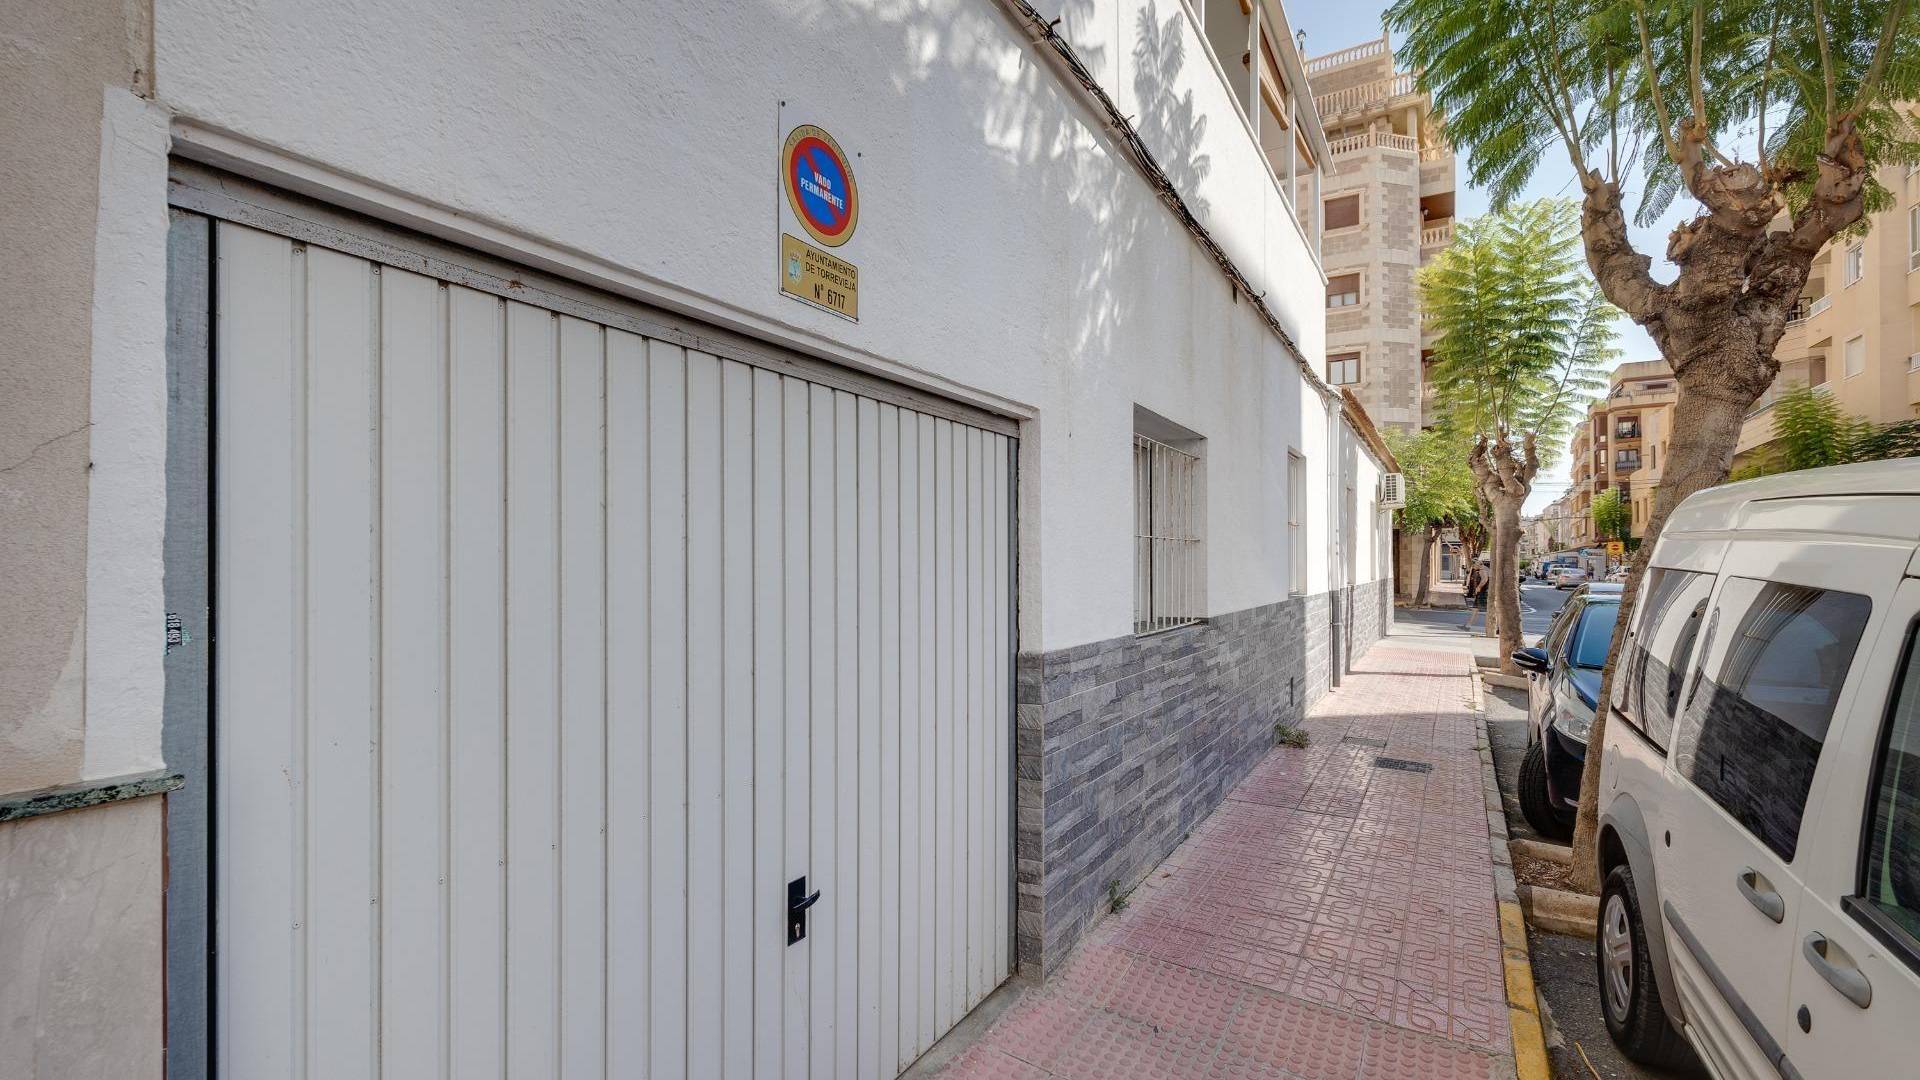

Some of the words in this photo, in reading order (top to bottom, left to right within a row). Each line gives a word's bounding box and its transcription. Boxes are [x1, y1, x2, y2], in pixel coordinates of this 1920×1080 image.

[800, 177, 844, 210] PERMANENTE
[814, 171, 832, 190] VADO
[805, 261, 815, 274] DE
[816, 266, 857, 292] TORREVIEJA
[806, 249, 856, 280] AYUNTAMIENTO
[827, 288, 846, 310] 6717
